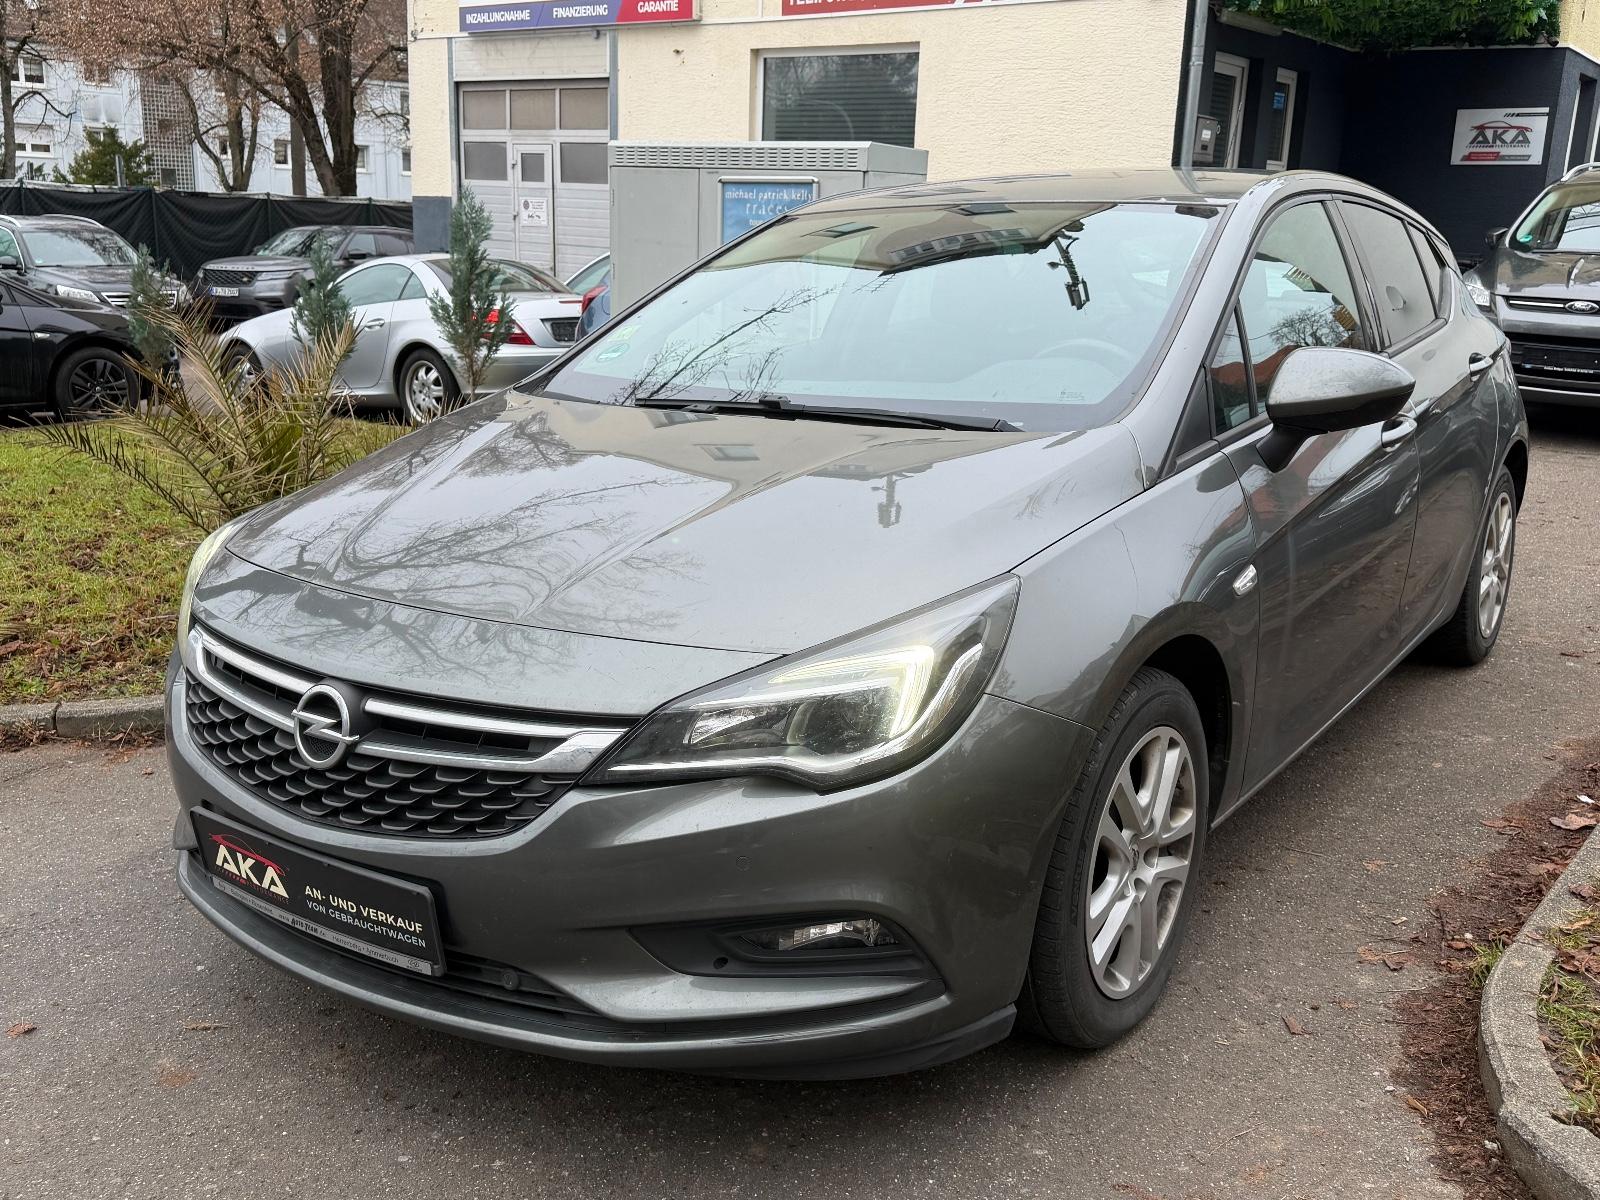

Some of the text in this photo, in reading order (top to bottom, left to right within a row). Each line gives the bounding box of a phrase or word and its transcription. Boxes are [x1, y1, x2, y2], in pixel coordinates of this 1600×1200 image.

[552, 4, 609, 19] FINANZIERUNG
[637, 0, 679, 13] GARANTIE
[465, 9, 531, 24] INZAHLUNGNAHME
[1468, 129, 1531, 145] AKA
[725, 187, 814, 201] michael patrick kelly
[215, 844, 290, 899] AKA
[304, 885, 424, 934] AN- UND VERKAUF
[306, 899, 427, 948] VON GEBRAUCHTWAGEN
